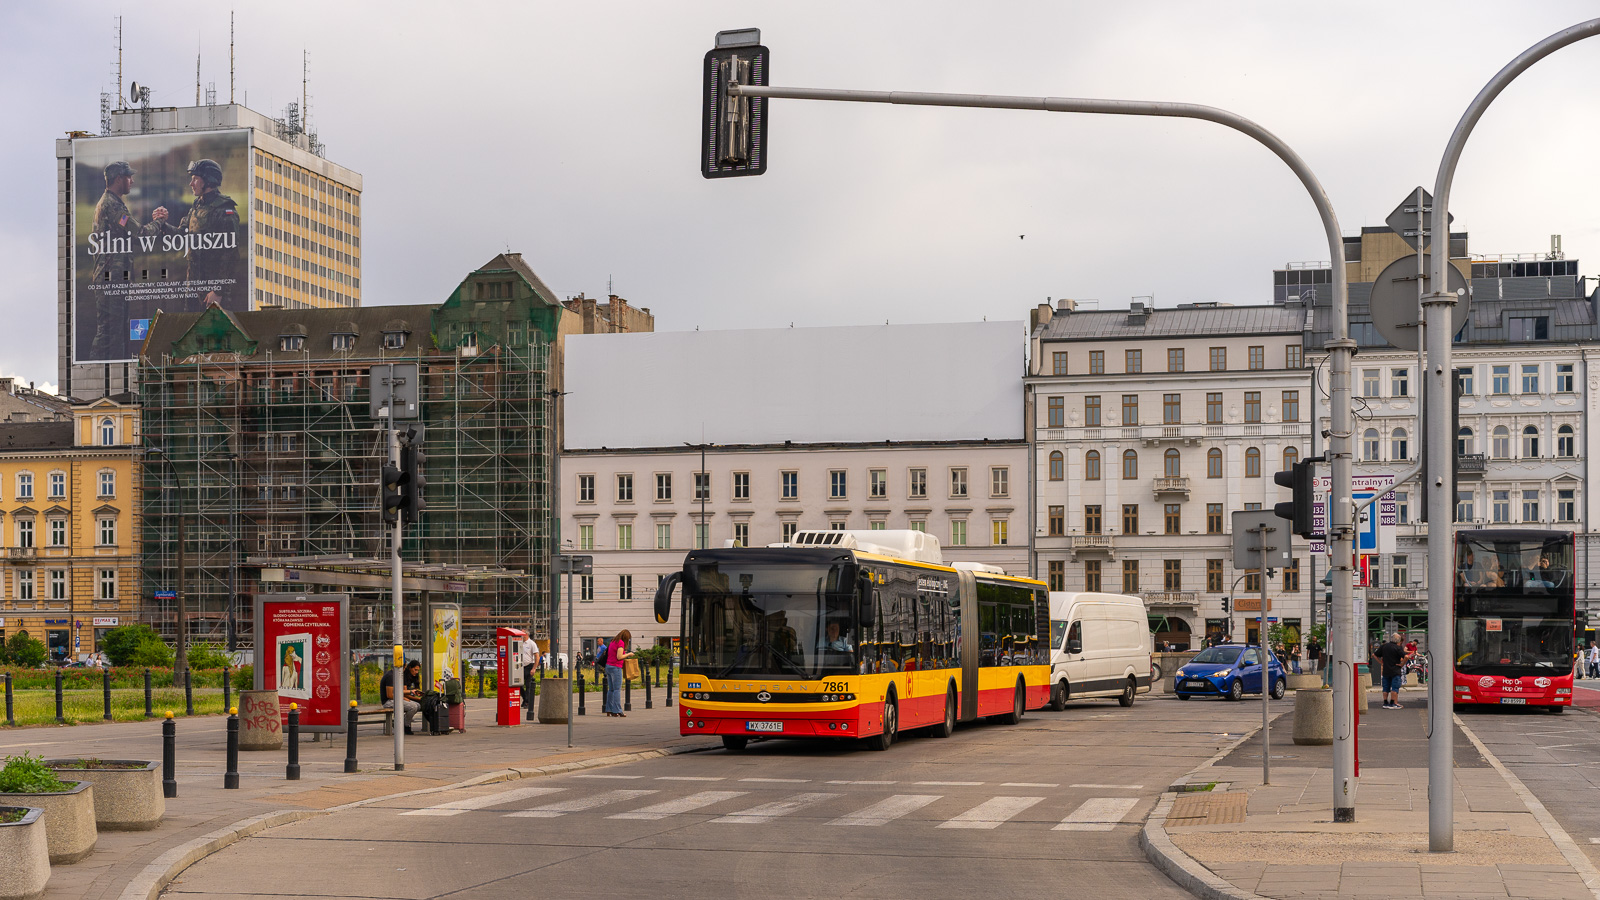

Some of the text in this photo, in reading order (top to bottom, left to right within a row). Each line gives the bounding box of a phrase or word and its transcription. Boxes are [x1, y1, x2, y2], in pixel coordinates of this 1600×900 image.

[88, 228, 237, 258] Silni w sojuszu
[822, 682, 849, 692] 7861
